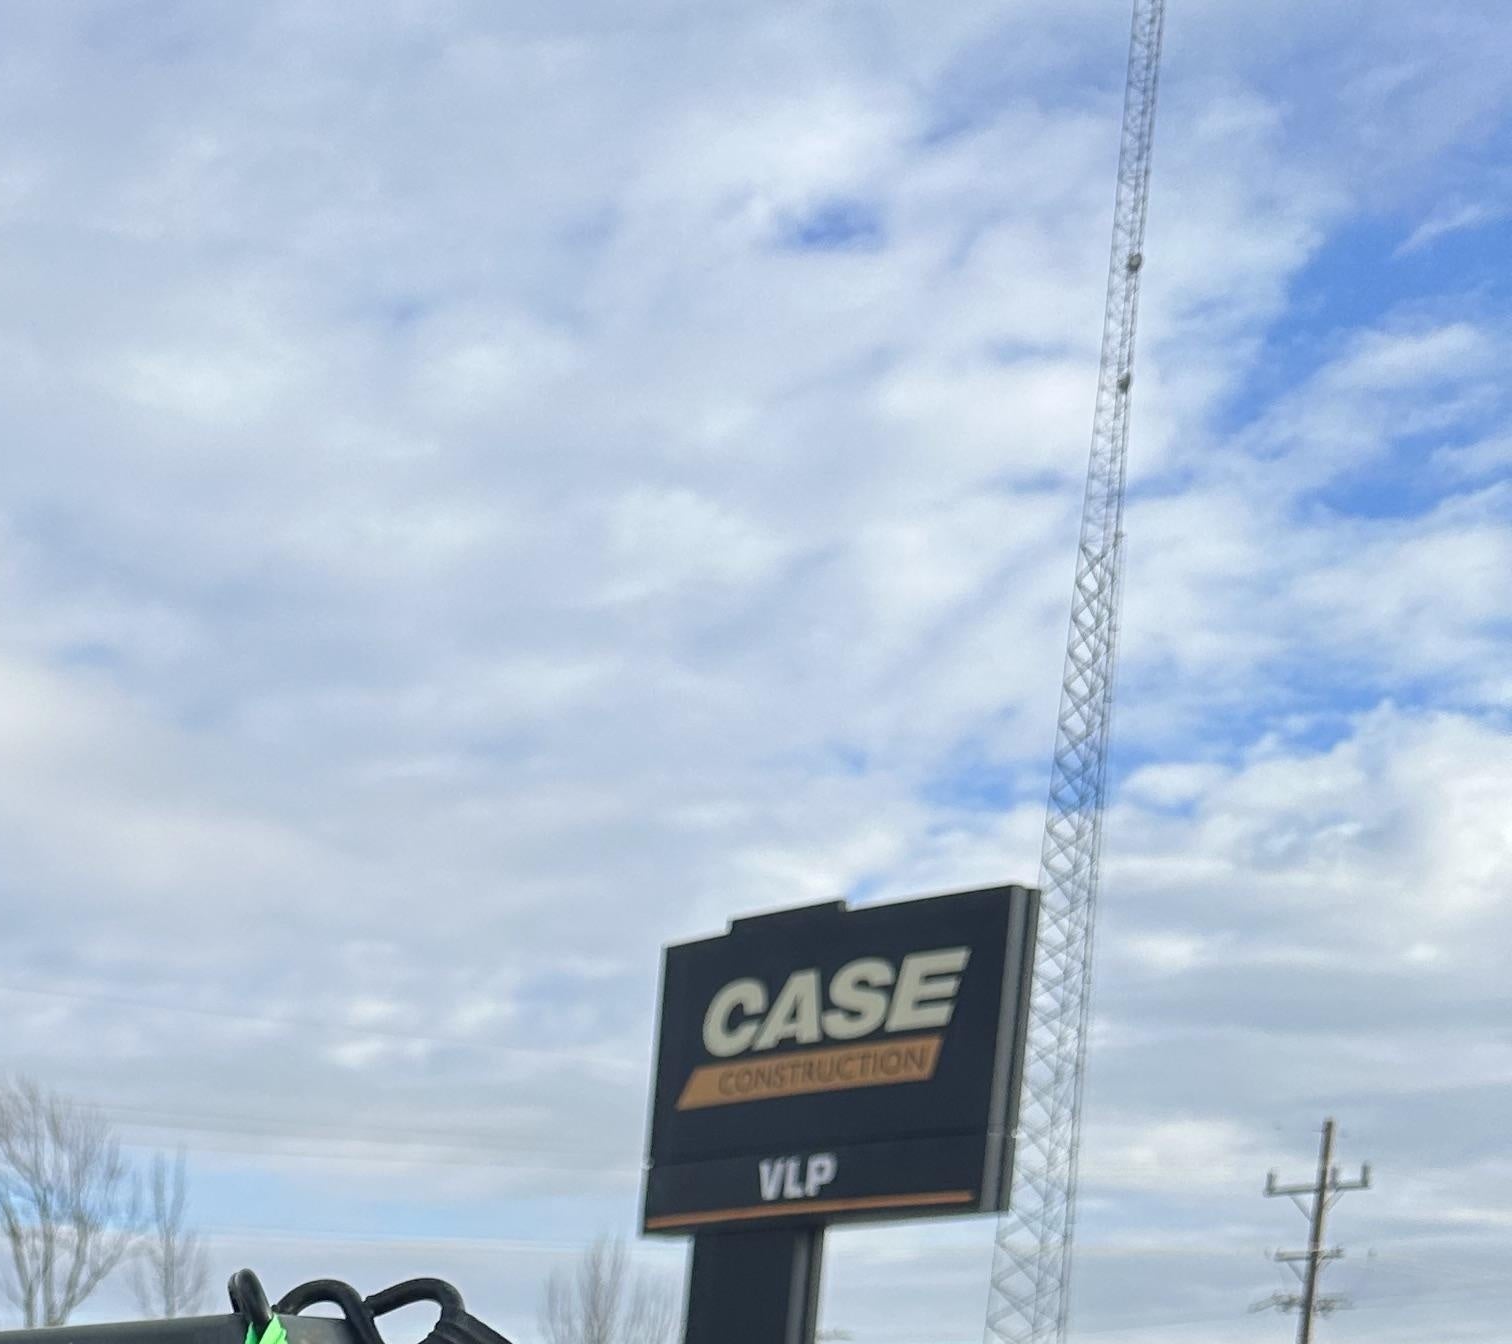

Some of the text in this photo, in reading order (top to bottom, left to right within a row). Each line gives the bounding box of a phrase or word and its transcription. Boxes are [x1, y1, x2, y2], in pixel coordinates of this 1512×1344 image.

[702, 946, 973, 1057] CASE
[717, 1045, 931, 1098] CONSTRUCTION
[758, 1152, 838, 1201] VLP
